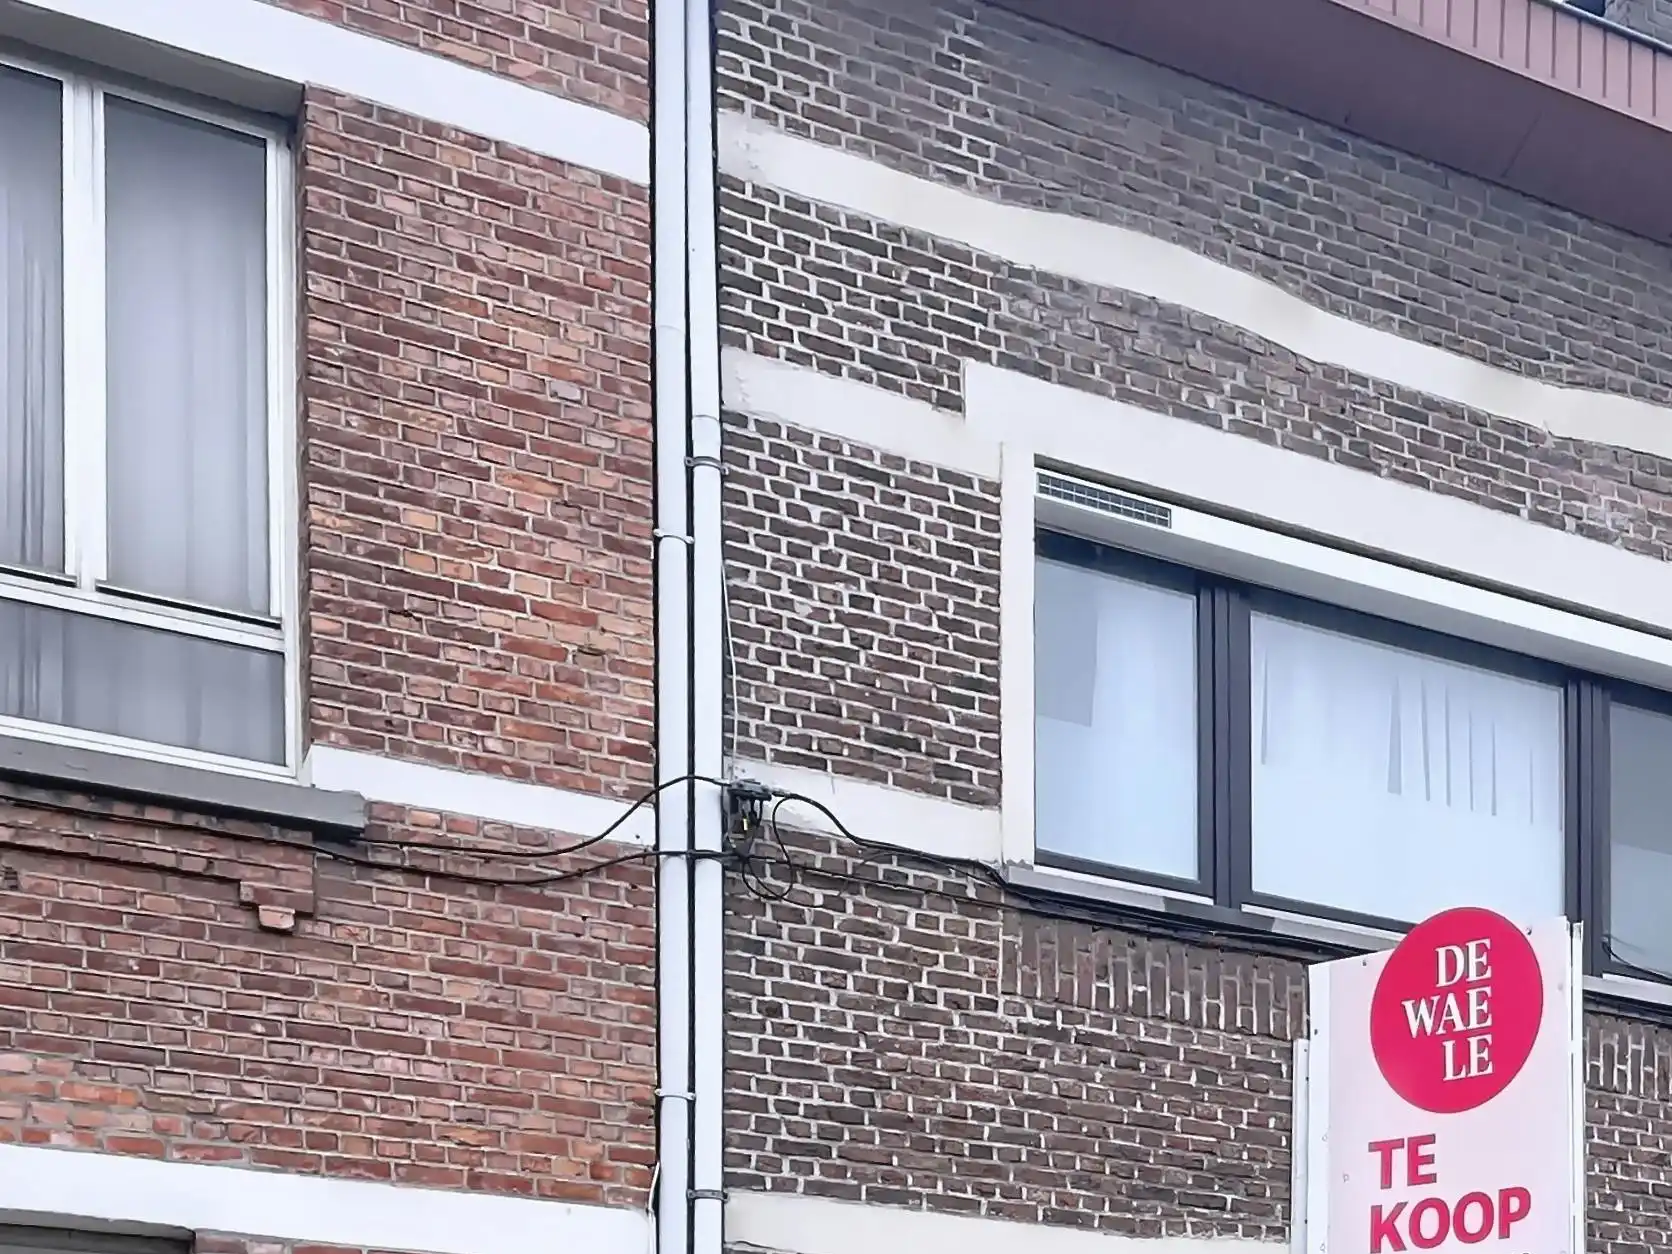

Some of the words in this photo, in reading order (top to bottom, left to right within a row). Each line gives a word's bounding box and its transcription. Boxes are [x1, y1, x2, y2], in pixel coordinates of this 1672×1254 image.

[1435, 938, 1493, 988] DE
[1401, 986, 1493, 1039] WAE
[1442, 1034, 1494, 1082] LE
[1368, 1133, 1437, 1190] TE
[1369, 1186, 1532, 1254] KOOP
